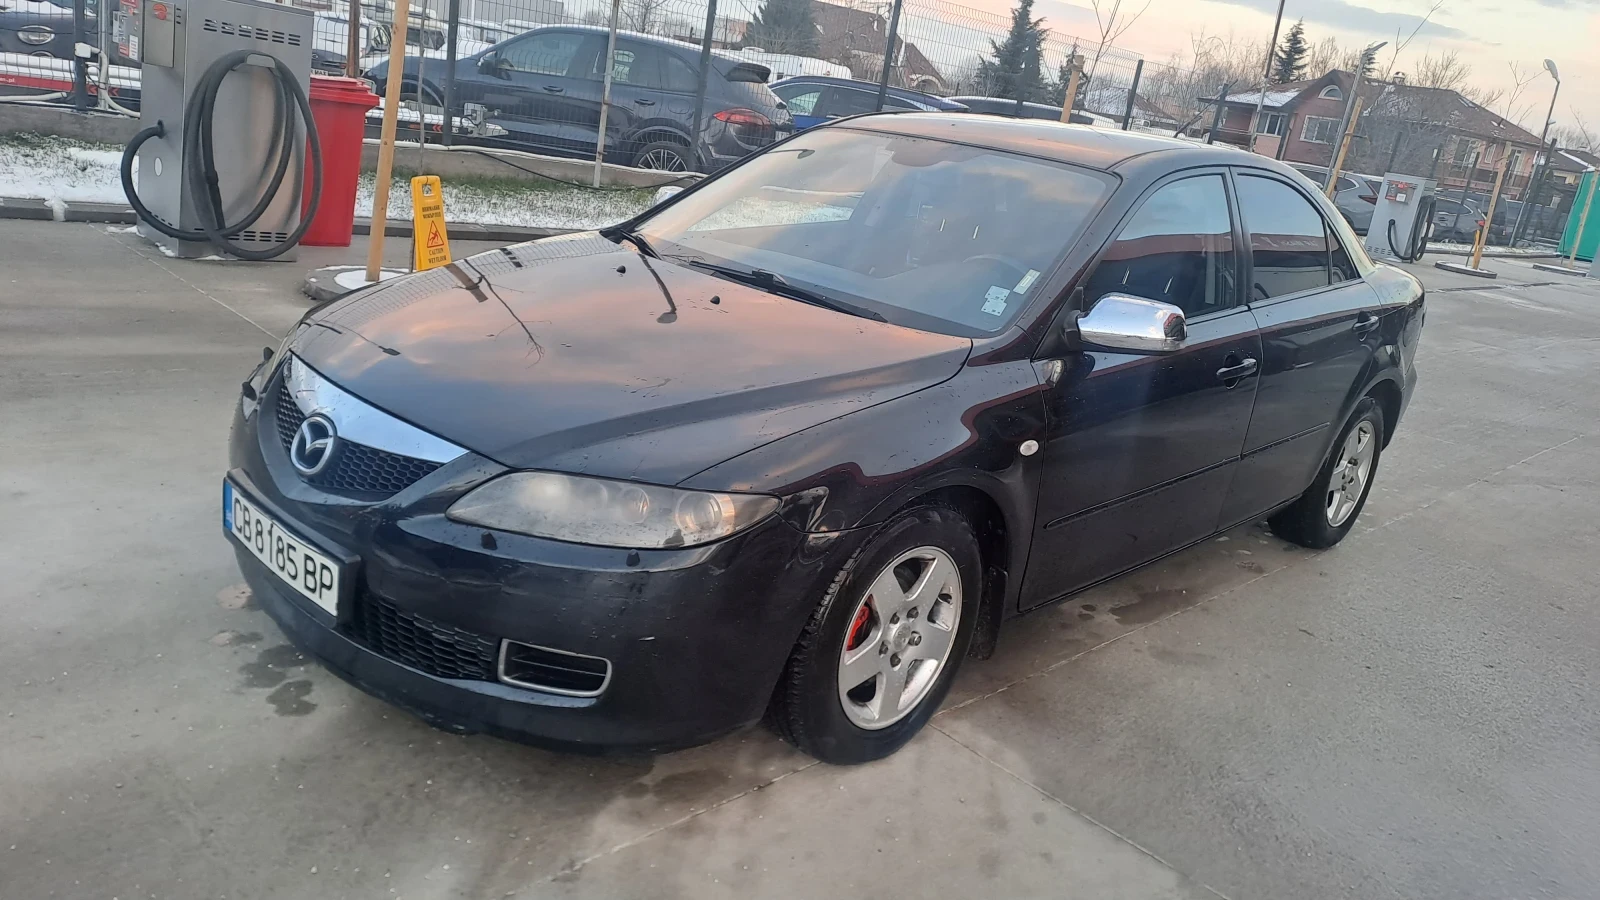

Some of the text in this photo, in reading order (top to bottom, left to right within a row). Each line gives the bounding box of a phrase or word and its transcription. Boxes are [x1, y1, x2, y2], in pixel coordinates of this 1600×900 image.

[233, 497, 334, 600] CB 8185 BP
